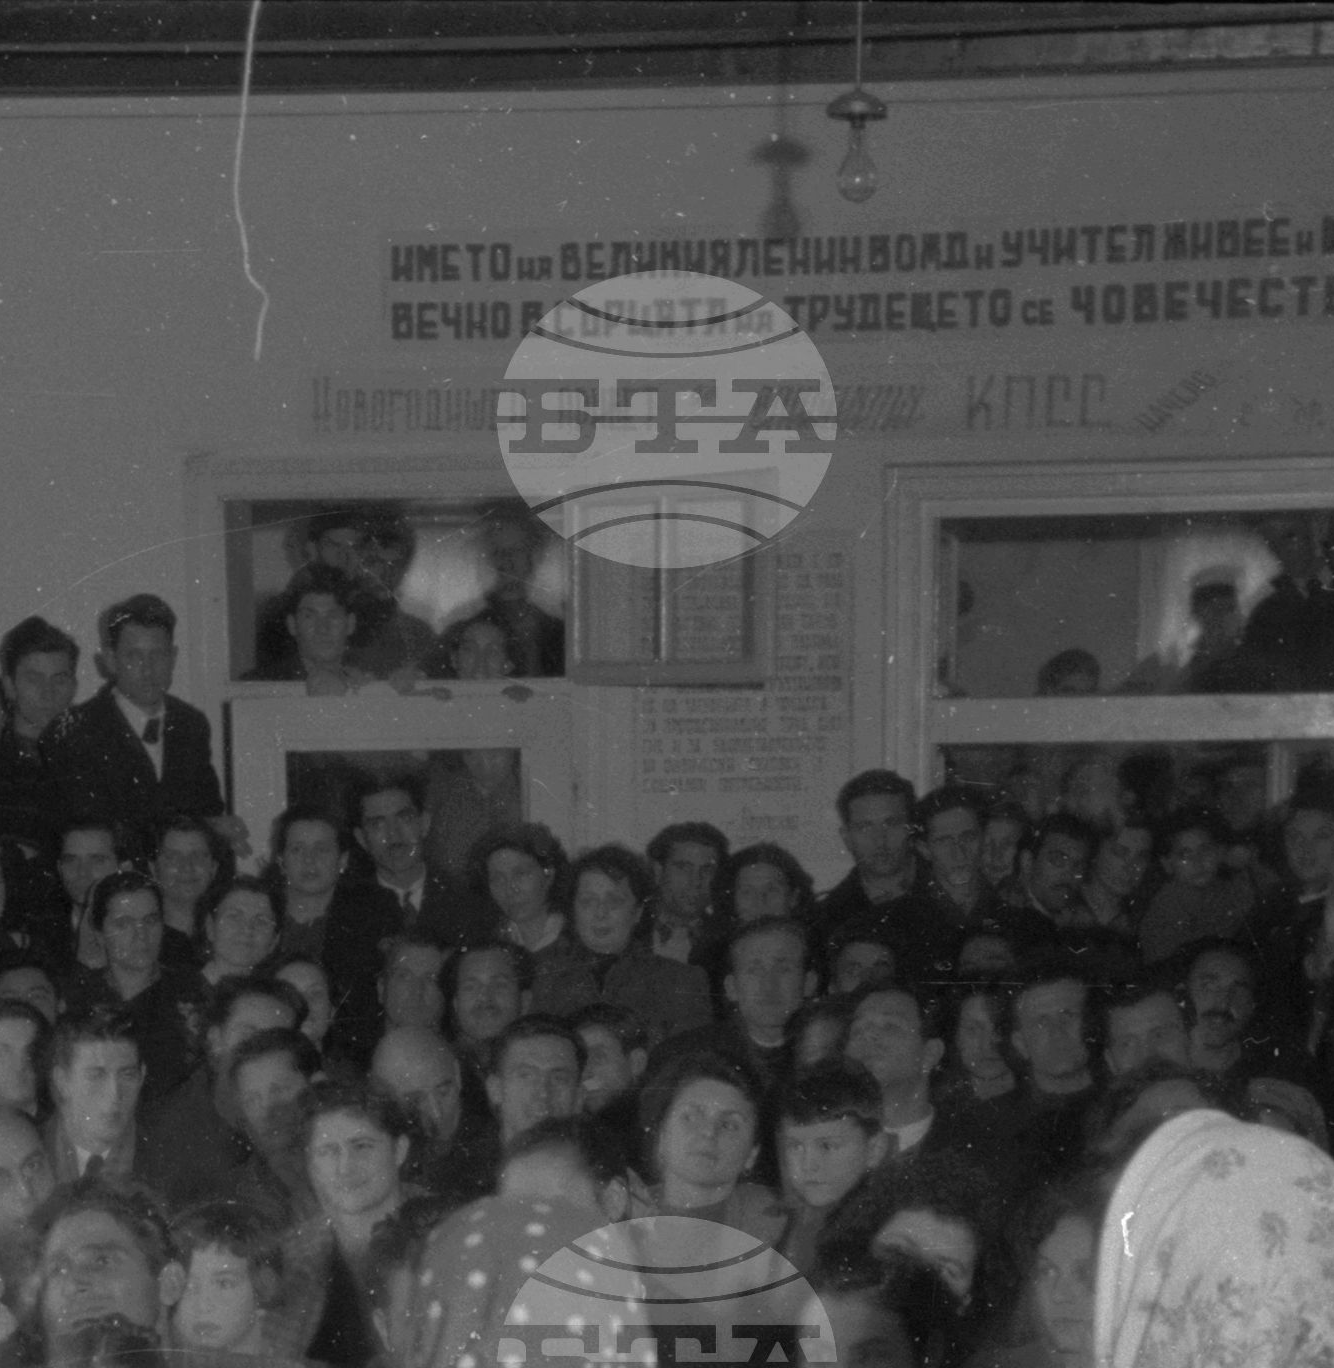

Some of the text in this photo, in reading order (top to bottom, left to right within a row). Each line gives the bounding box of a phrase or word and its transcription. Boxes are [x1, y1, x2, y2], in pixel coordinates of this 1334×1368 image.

[391, 242, 512, 282] ИМЕТО
[560, 239, 730, 281] ВЕЛИКИЯ
[734, 235, 861, 277] ЛЕНИН
[868, 231, 969, 273] ВОЖД
[1000, 224, 1156, 269] УЧИТЕЛ
[1163, 216, 1291, 262] ЖИВЕЕ
[391, 300, 512, 340] ВЕЧНО
[783, 288, 1012, 334] ТРУДЕЩЕТО
[965, 372, 1113, 431] КПСС
